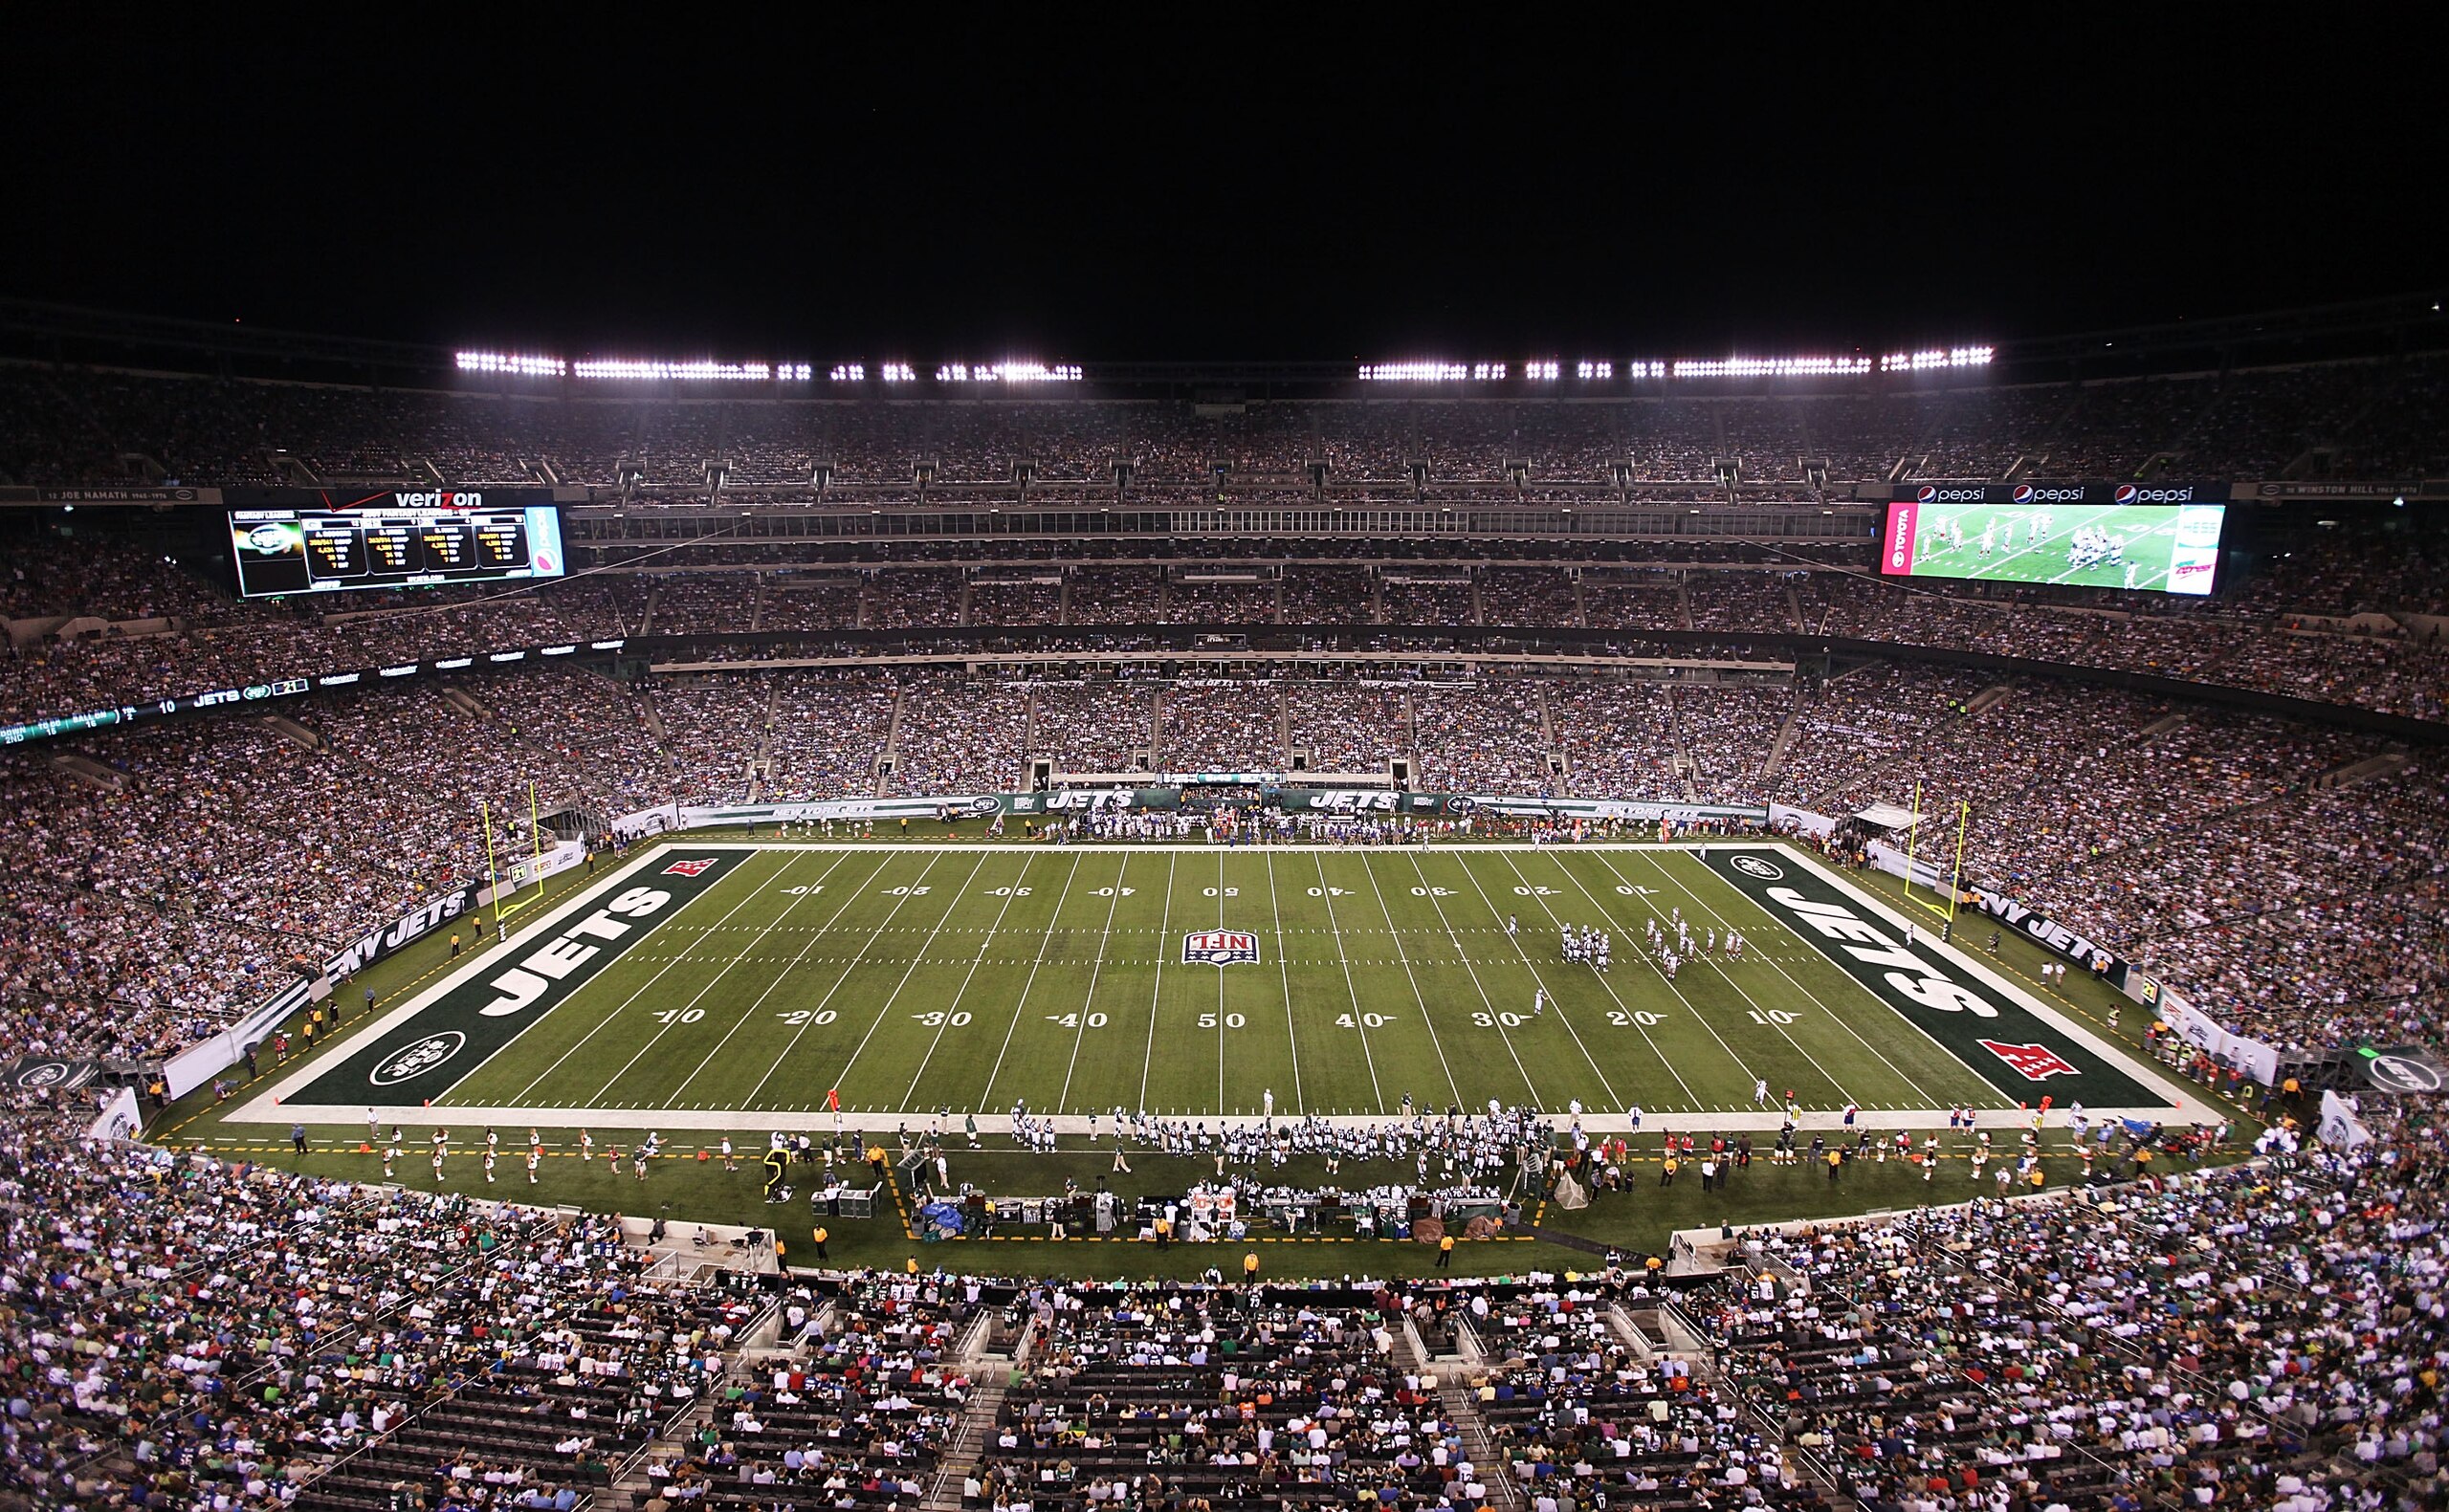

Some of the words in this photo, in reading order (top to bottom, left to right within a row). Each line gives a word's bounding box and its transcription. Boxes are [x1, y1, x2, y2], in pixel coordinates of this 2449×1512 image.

[60, 491, 80, 499] JOE
[84, 491, 128, 500] NAMATH
[1938, 488, 1985, 502] pepsi
[2034, 487, 2085, 502] pepsi
[2136, 487, 2193, 503] pepsi
[2298, 486, 2346, 494] WINSTON
[395, 489, 482, 508] verizon
[1893, 509, 1909, 551] TOYOTA
[283, 682, 298, 693] 21
[159, 701, 176, 713] 10
[193, 690, 240, 708] JETS
[5, 734, 24, 744] 2ND
[1046, 791, 1135, 808] JETS
[1310, 791, 1401, 808] JETS
[773, 806, 805, 816] NEW
[805, 805, 841, 815] YORK
[841, 804, 875, 813] JETS
[1595, 804, 1622, 814] NEW
[1623, 806, 1660, 815] YORK
[1661, 808, 1700, 817] JETS
[513, 869, 526, 880] 21
[791, 885, 826, 896] 10
[892, 885, 932, 896] 20
[994, 886, 1033, 897] 30
[1097, 887, 1136, 897] 40
[1202, 887, 1240, 897] 50
[1308, 887, 1344, 897] 40
[1411, 886, 1447, 897] 30
[1513, 885, 1551, 896] 20
[1616, 885, 1649, 895] 10
[340, 930, 385, 973] NY
[386, 890, 466, 950] JETS
[1193, 933, 1249, 950] NFL
[2027, 918, 2114, 974] JETS
[478, 887, 672, 1017] JETS
[1766, 887, 1999, 1018] JETS
[2143, 981, 2154, 997] 21
[657, 1009, 705, 1023] 10
[784, 1010, 838, 1025] 20
[921, 1011, 972, 1027] 30
[1058, 1012, 1108, 1027] 40
[1198, 1013, 1246, 1028] 50
[1335, 1012, 1384, 1028] 40
[1471, 1012, 1521, 1027] 30
[1606, 1011, 1657, 1025] 20
[1746, 1009, 1794, 1023] 10
[2378, 1058, 2433, 1090] JETS
